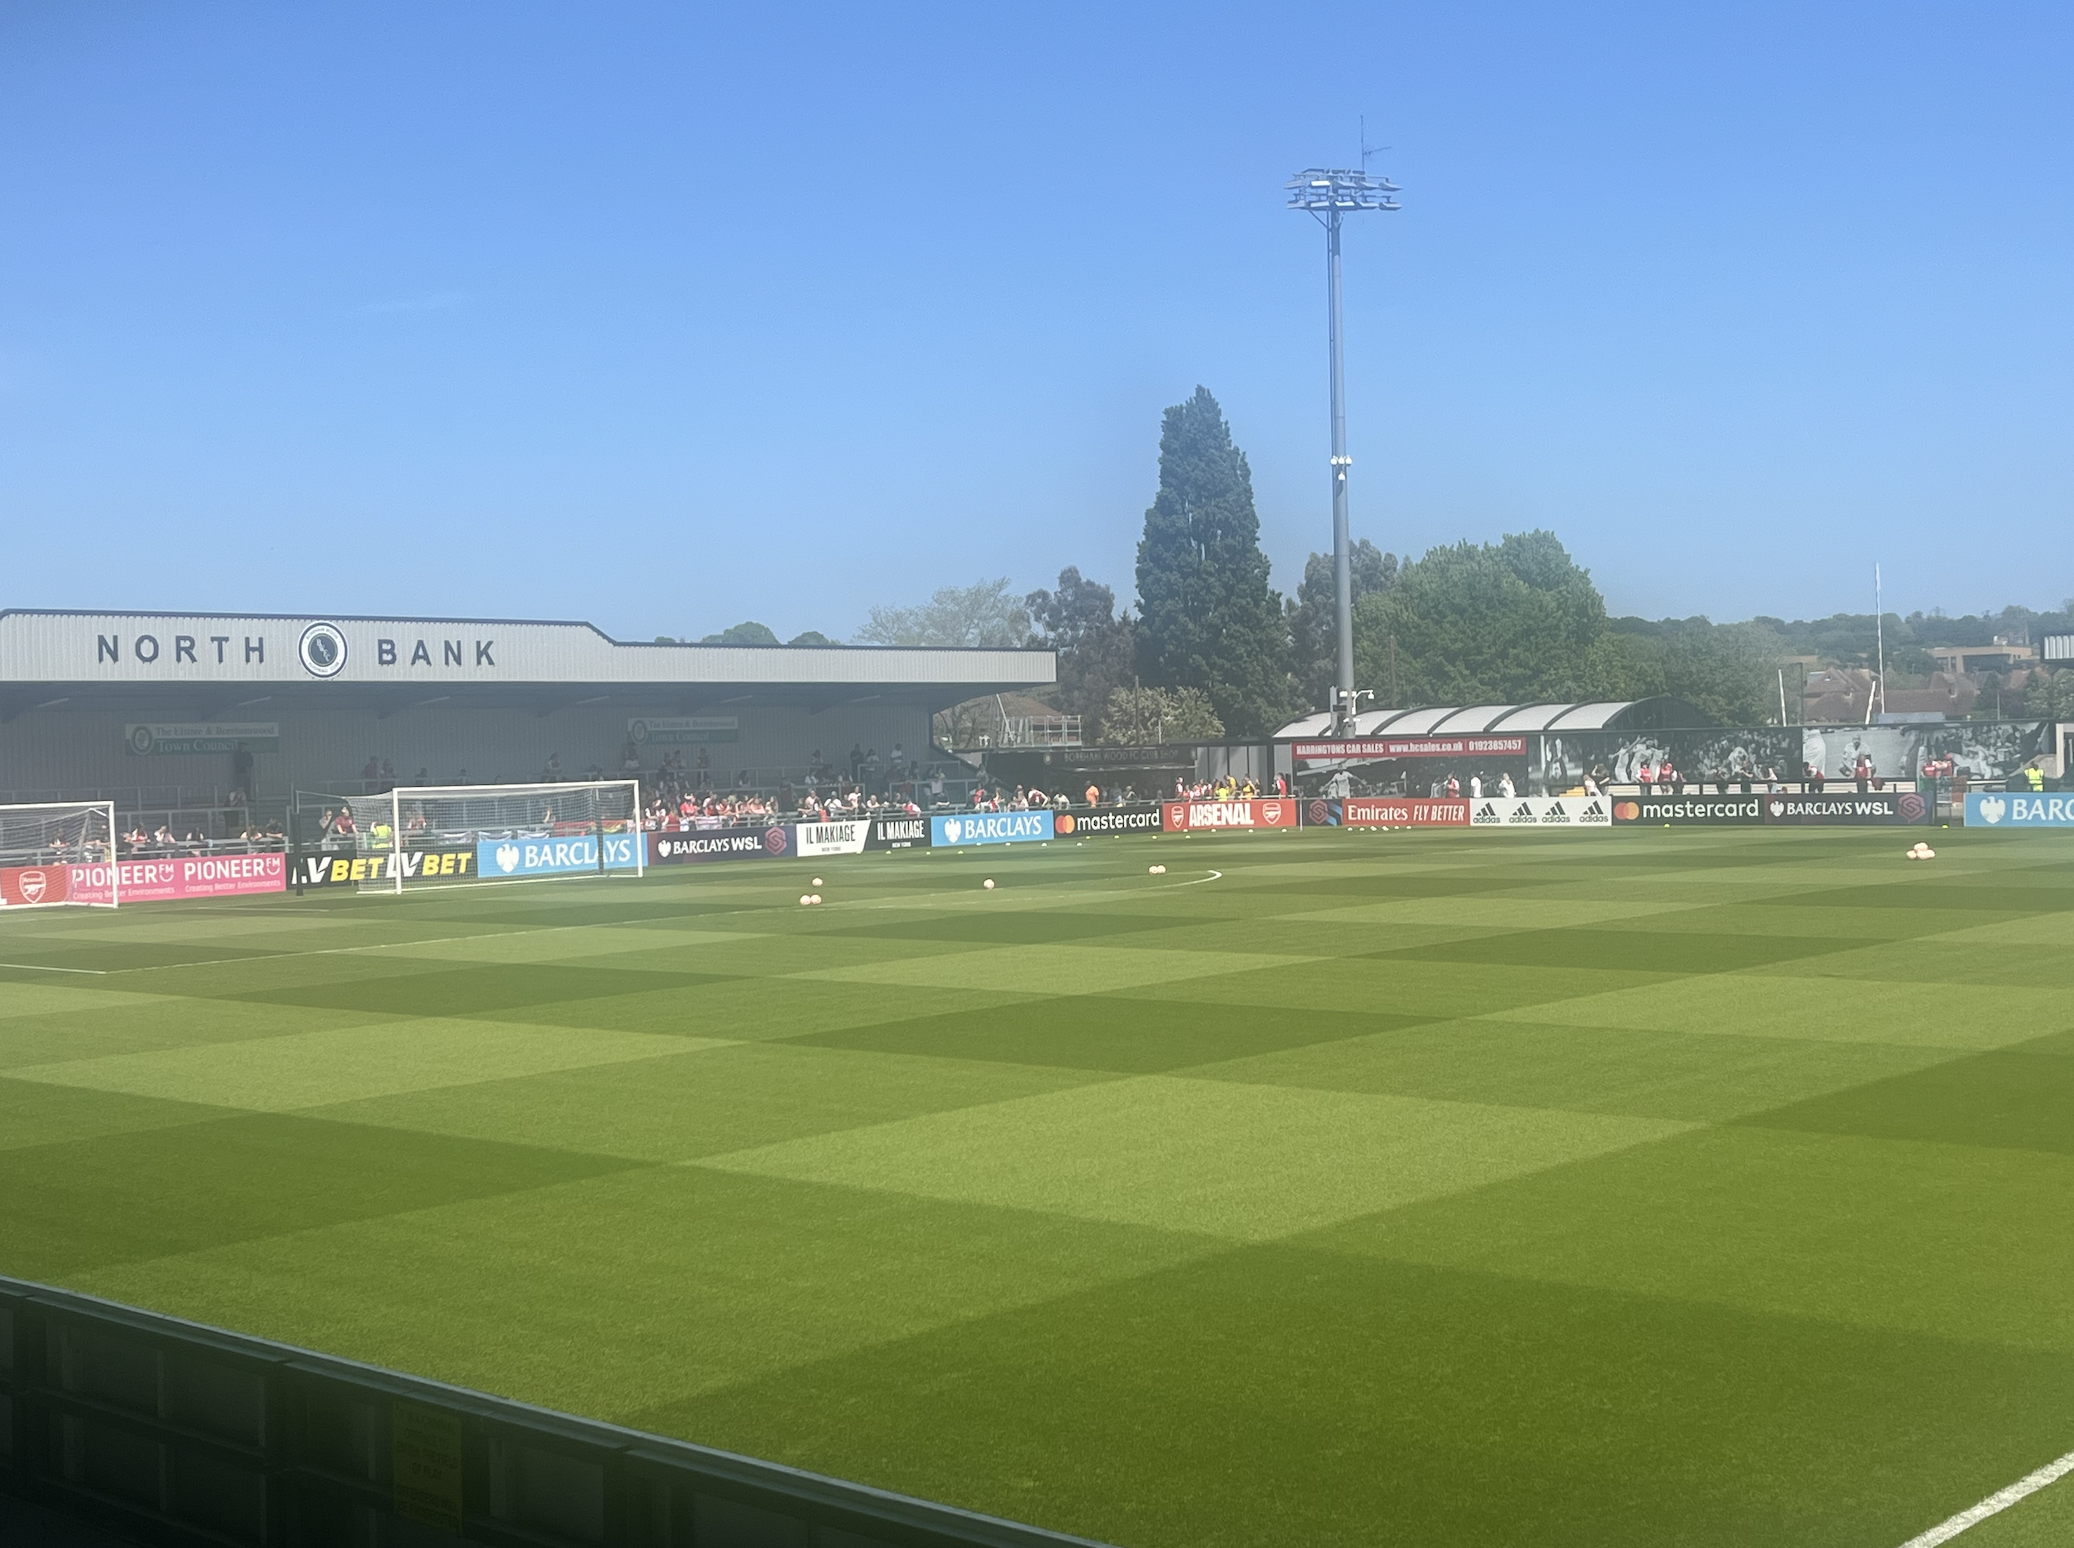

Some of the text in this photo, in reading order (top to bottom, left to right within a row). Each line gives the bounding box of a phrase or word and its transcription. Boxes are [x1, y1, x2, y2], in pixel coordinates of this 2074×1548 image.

[97, 634, 496, 668] NORTH BANK
[155, 727, 172, 736] The
[157, 739, 238, 753] Town Council
[1346, 743, 1362, 754] CAR
[1362, 743, 1384, 754] SALES
[1189, 802, 1254, 827] ARSENAL
[1347, 804, 1465, 821] Emirates FLY BETTER
[1643, 799, 1759, 818] mastercard
[1786, 801, 1894, 816] BARCLAYS WSL
[1077, 809, 1160, 831] mastercard
[1472, 815, 1501, 824] adidas
[1508, 814, 1537, 824] adidas
[1541, 814, 1571, 823] adidas
[1579, 813, 1608, 823] adidas
[806, 824, 856, 844] IL MAKIAGE
[877, 820, 925, 841] IL MAKIAGE
[965, 816, 1042, 840] BARCLAYS
[673, 836, 762, 855] BARCLAYS WSL
[71, 864, 158, 889] PIONEER
[184, 858, 265, 882] PIONEER
[185, 879, 281, 894] Creating Better Environments
[73, 890, 104, 901] Creating
